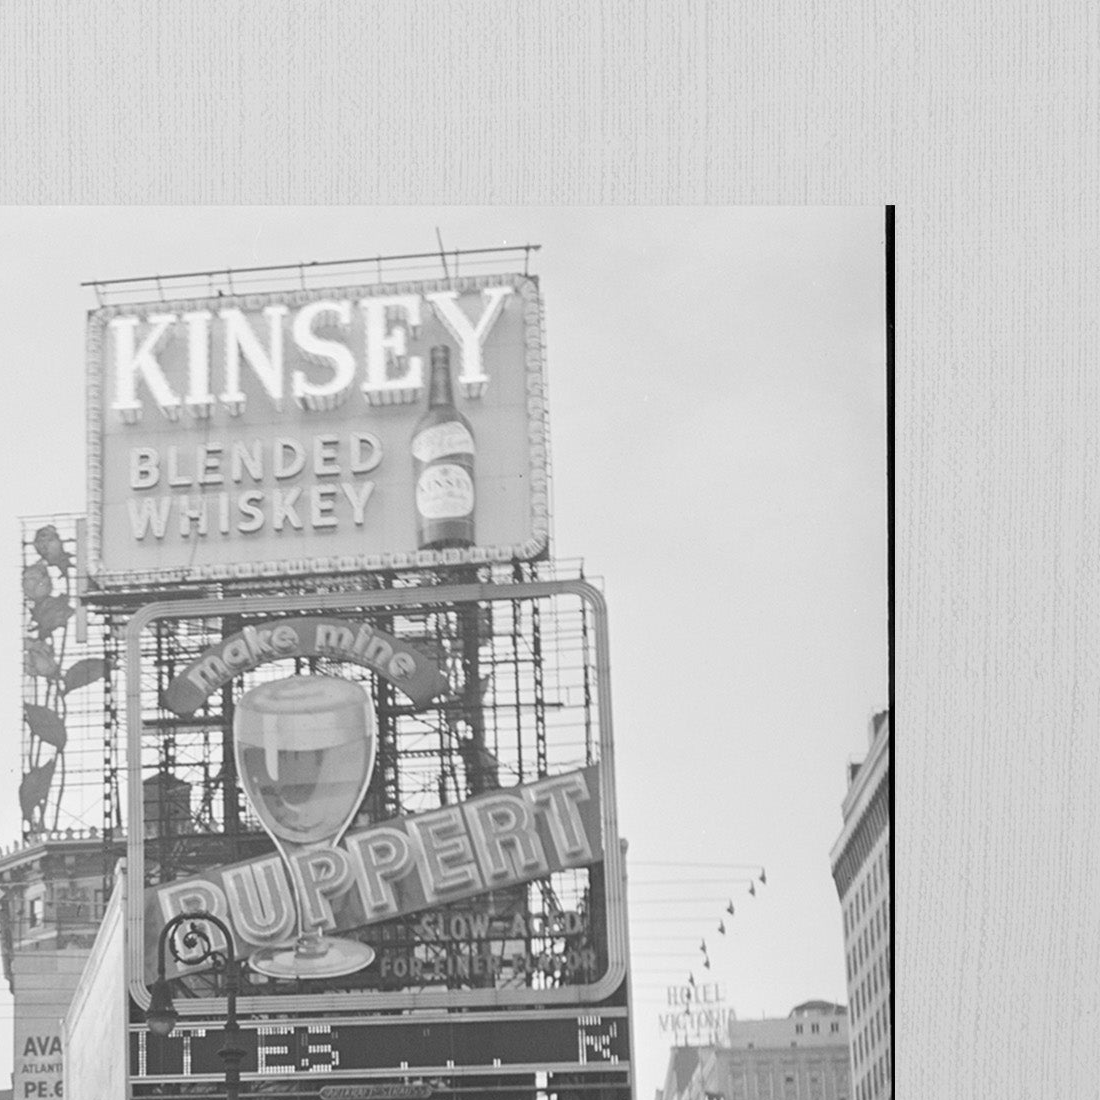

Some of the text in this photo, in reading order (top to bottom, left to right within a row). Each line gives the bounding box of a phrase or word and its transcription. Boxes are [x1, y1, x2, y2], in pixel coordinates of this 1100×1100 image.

[111, 286, 513, 414] KINSEY
[129, 431, 384, 490] BLENDED
[127, 480, 377, 540] WHISKEY
[187, 622, 417, 691] make mine
[158, 770, 592, 972] RUPPERT
[380, 957, 423, 979] FOR
